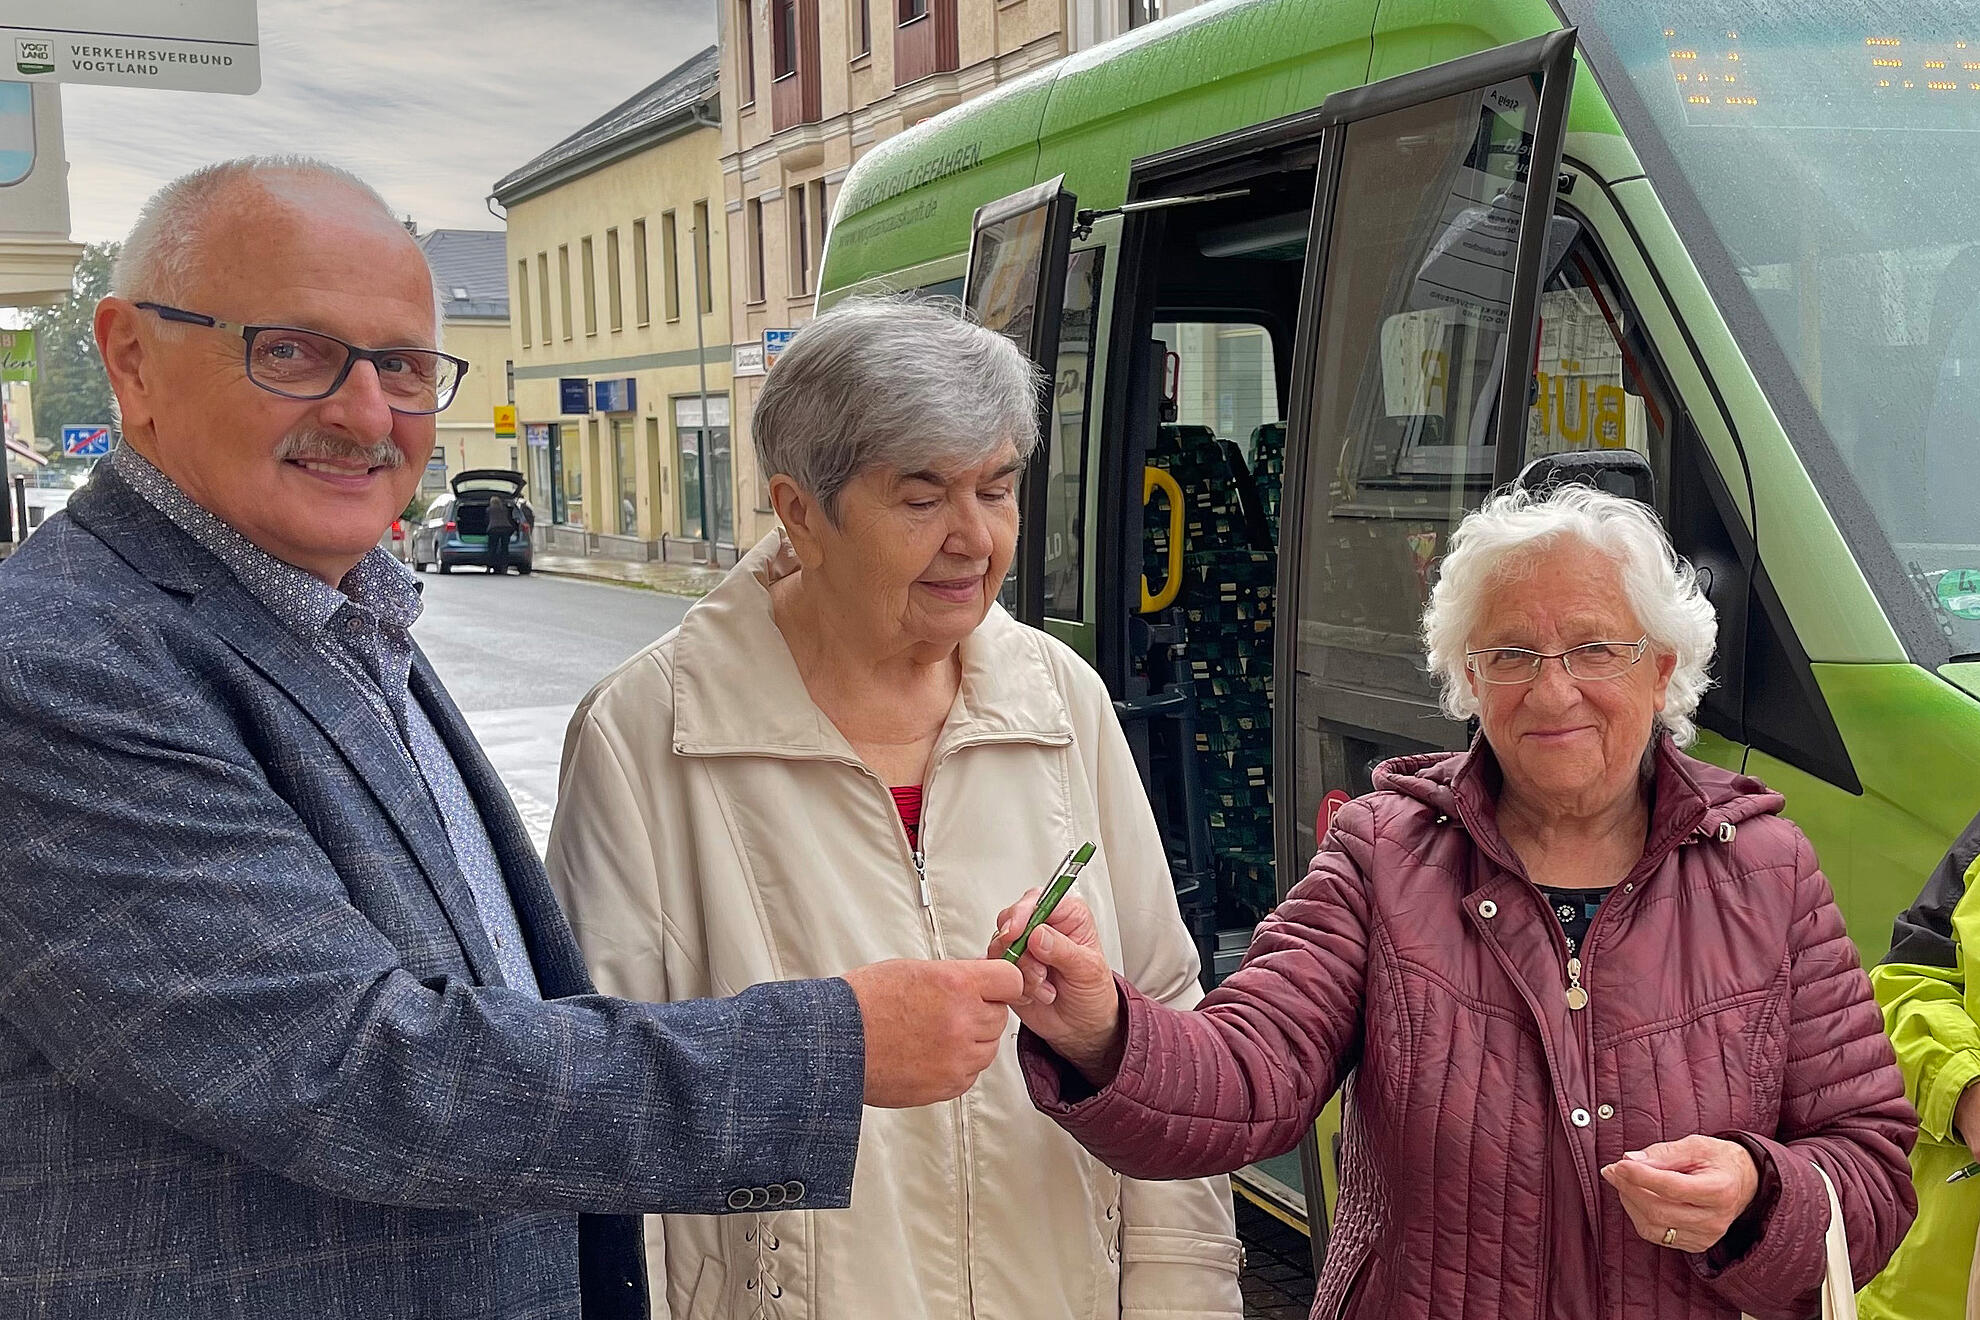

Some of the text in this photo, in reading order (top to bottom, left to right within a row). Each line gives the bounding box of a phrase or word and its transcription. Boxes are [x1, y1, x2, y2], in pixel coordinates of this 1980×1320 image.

[21, 42, 48, 51] VOGT
[22, 51, 48, 60] LAND
[71, 45, 233, 67] VERKEHRSVERBUND
[72, 60, 158, 75] VOGTLAND
[888, 168, 914, 198] GUT
